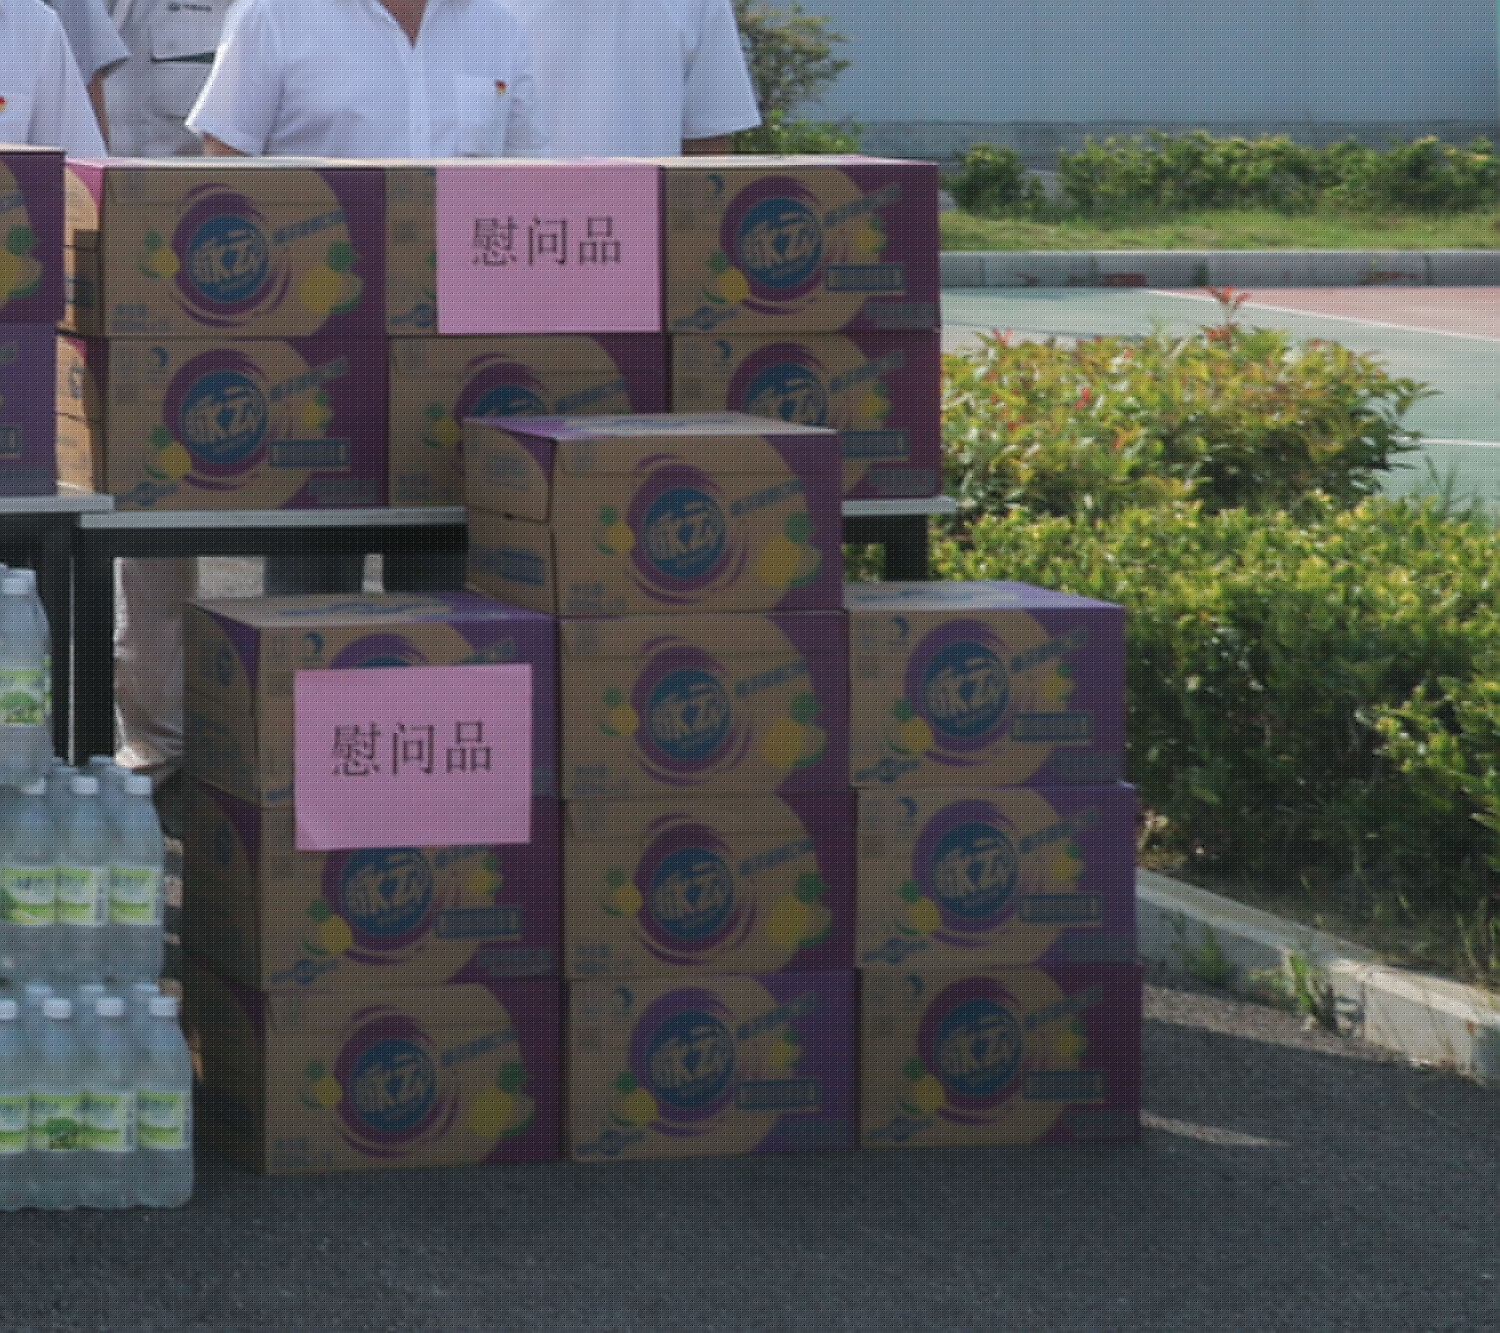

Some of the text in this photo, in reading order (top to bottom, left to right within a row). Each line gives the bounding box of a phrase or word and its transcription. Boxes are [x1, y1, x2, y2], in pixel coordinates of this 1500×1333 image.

[470, 215, 623, 268] 慰问品
[330, 720, 493, 779] 慰问品
